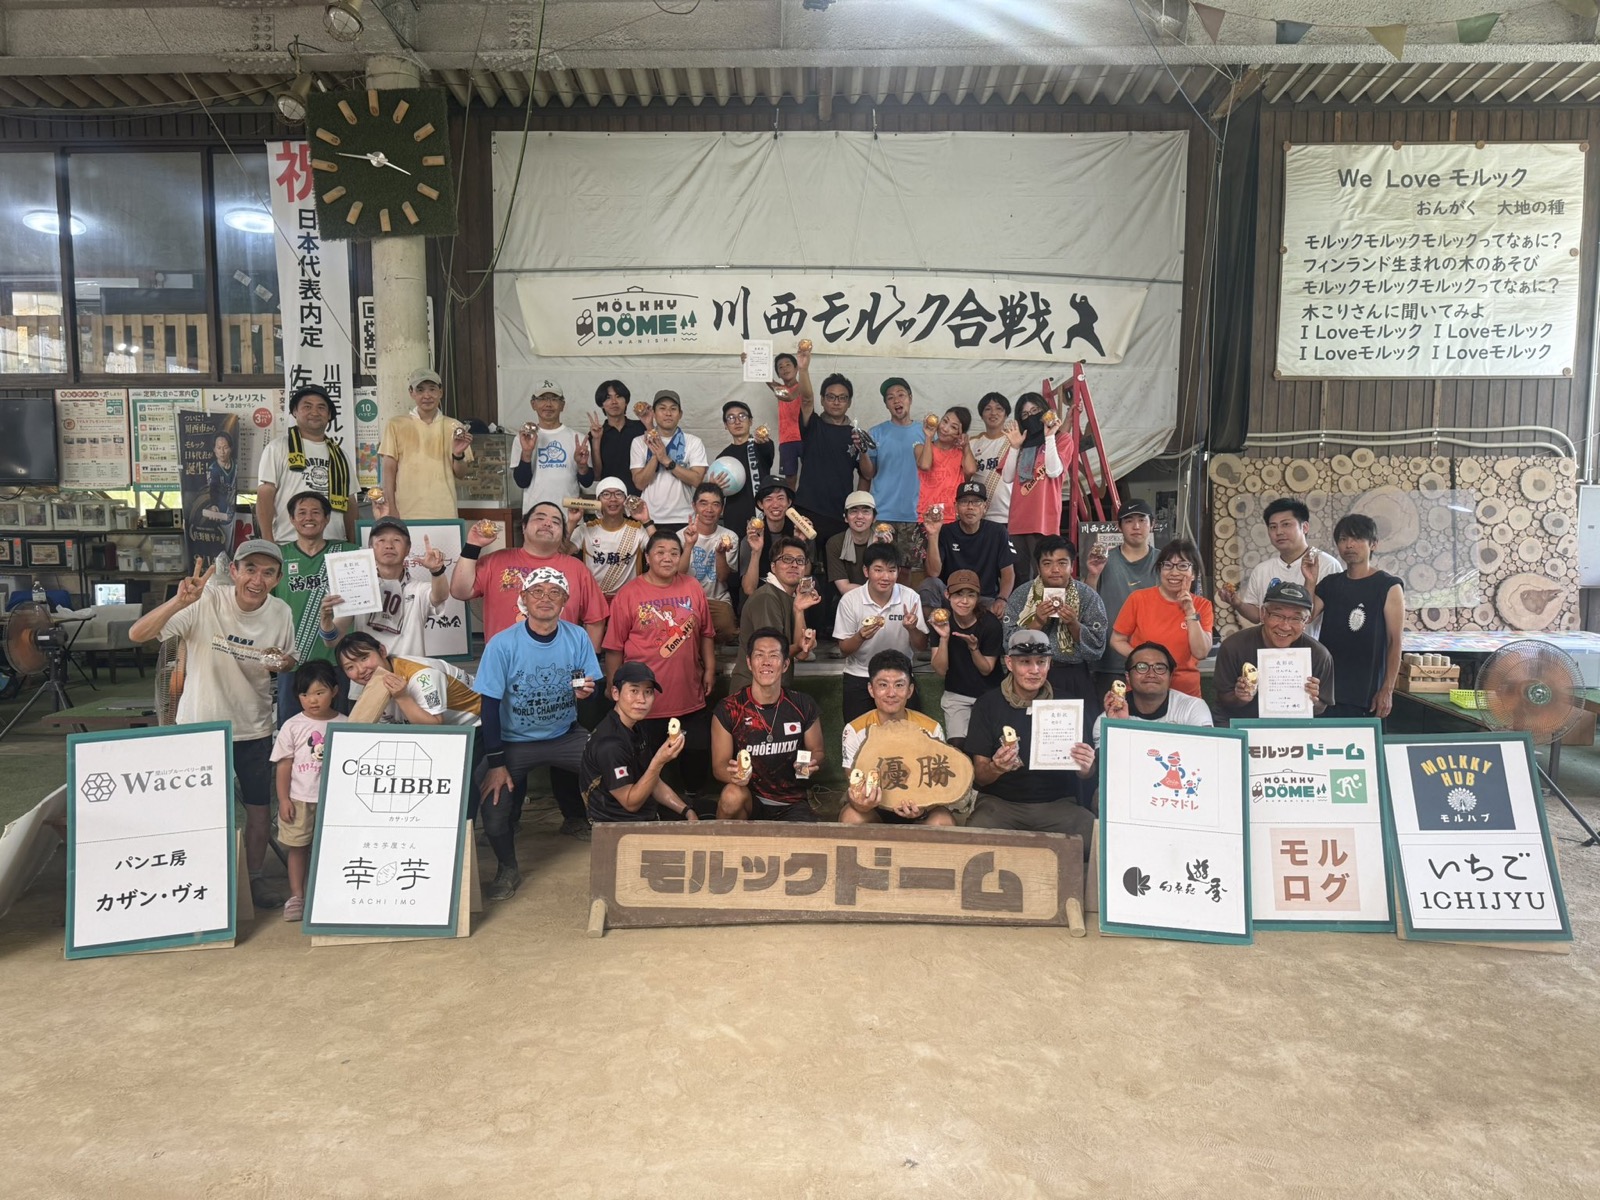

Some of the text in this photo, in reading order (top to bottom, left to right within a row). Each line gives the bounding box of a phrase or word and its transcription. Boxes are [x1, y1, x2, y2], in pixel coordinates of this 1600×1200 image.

[1337, 167, 1528, 188] We Love モルック
[1416, 199, 1565, 216] おんがく 大地の種
[1303, 254, 1539, 273] フィンランド生まれの木のあそび
[297, 208, 324, 349] 日本代表内定
[597, 298, 677, 313] MÖLKKY
[1301, 303, 1485, 320] 木こりさんに聞いてみよ
[597, 313, 677, 337] DÖME
[712, 284, 1053, 354] 川西モルック合戦
[143, 390, 191, 398] 定期大会のご案内
[212, 392, 267, 403] レンタルリスト
[360, 403, 371, 412] 10
[184, 451, 213, 460] 日本代表が
[382, 590, 402, 616] 10
[512, 706, 535, 716] WORLD
[746, 739, 799, 757] PHÖENIXXX
[1248, 743, 1365, 761] モルックドーム
[341, 758, 396, 777] Casa
[877, 753, 956, 791] 優勝
[1420, 754, 1493, 776] MOLKKY
[121, 770, 213, 795] Wacca
[373, 778, 451, 795] LIBRE
[1264, 776, 1314, 784] MÖLKKY
[1440, 770, 1476, 787] HUB
[1264, 784, 1315, 798] DÖME
[1149, 796, 1200, 811] ミアマドレ
[1440, 812, 1491, 823] モルハブ
[115, 849, 188, 871] パン工房
[1279, 839, 1348, 867] モル
[640, 845, 1024, 913] モルックドーム
[1283, 872, 1350, 903] ログ
[351, 897, 416, 906] SACHI IMO
